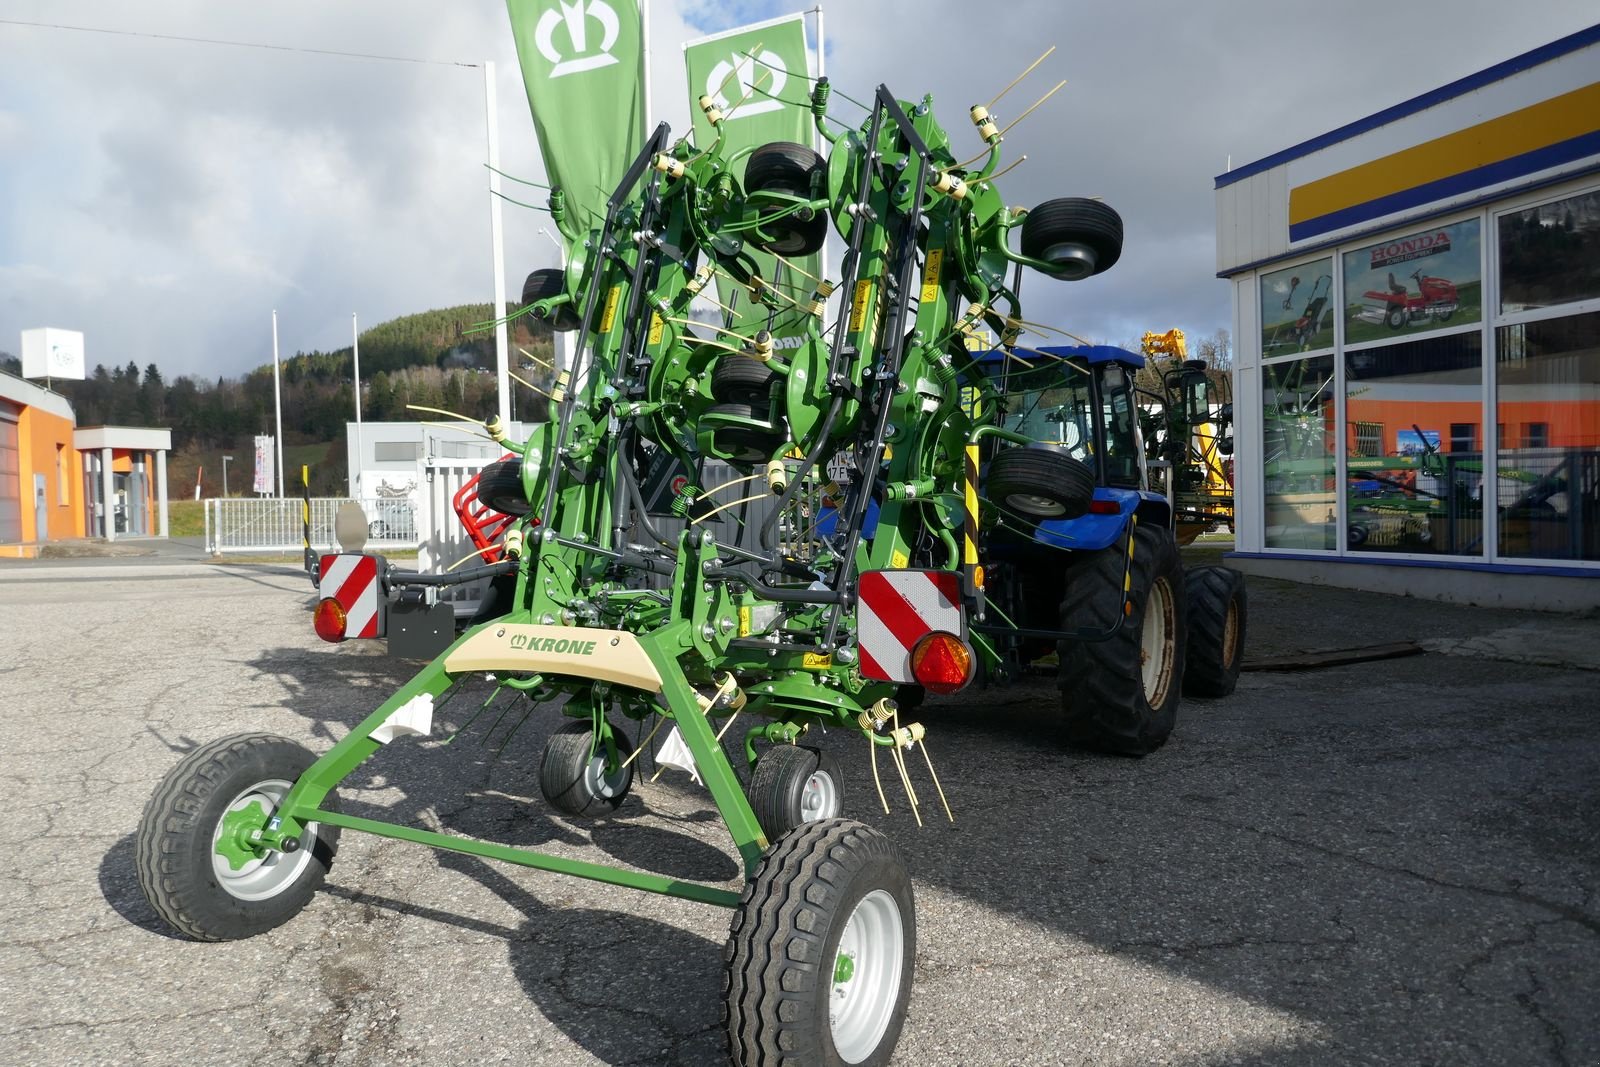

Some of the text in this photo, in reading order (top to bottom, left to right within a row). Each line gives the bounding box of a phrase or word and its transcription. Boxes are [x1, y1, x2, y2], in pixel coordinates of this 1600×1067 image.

[1371, 232, 1451, 261] HONDA
[1386, 255, 1404, 265] POWER
[527, 637, 597, 656] KRONE
